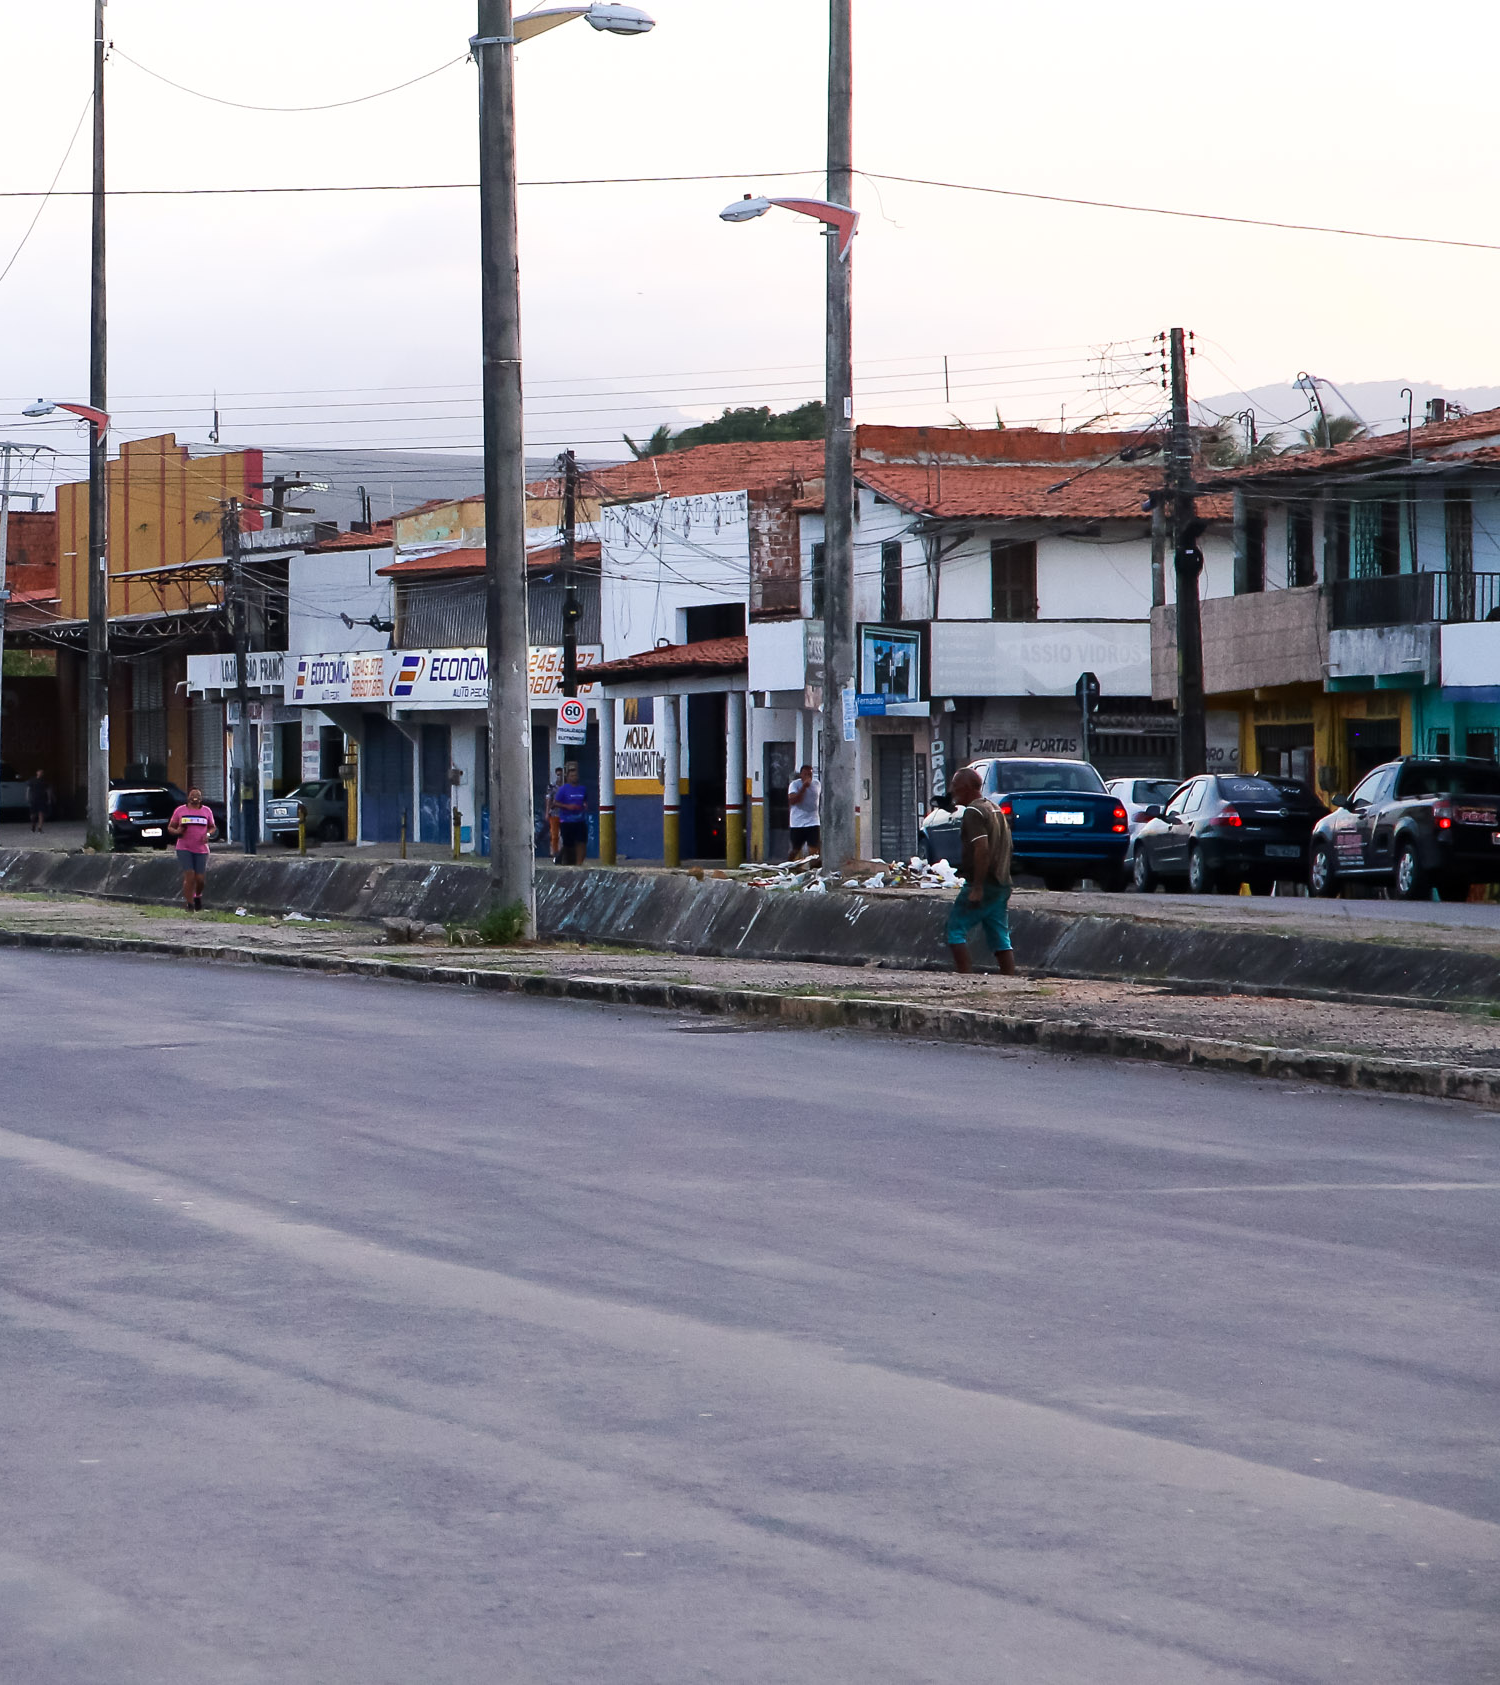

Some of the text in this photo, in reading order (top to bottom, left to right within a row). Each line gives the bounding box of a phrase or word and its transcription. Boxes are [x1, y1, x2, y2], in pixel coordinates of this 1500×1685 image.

[565, 706, 581, 717] 60
[623, 726, 655, 750] MOURA
[973, 738, 1077, 753] JANELA PORTAS
[615, 751, 662, 777] ACIONAMENTO
